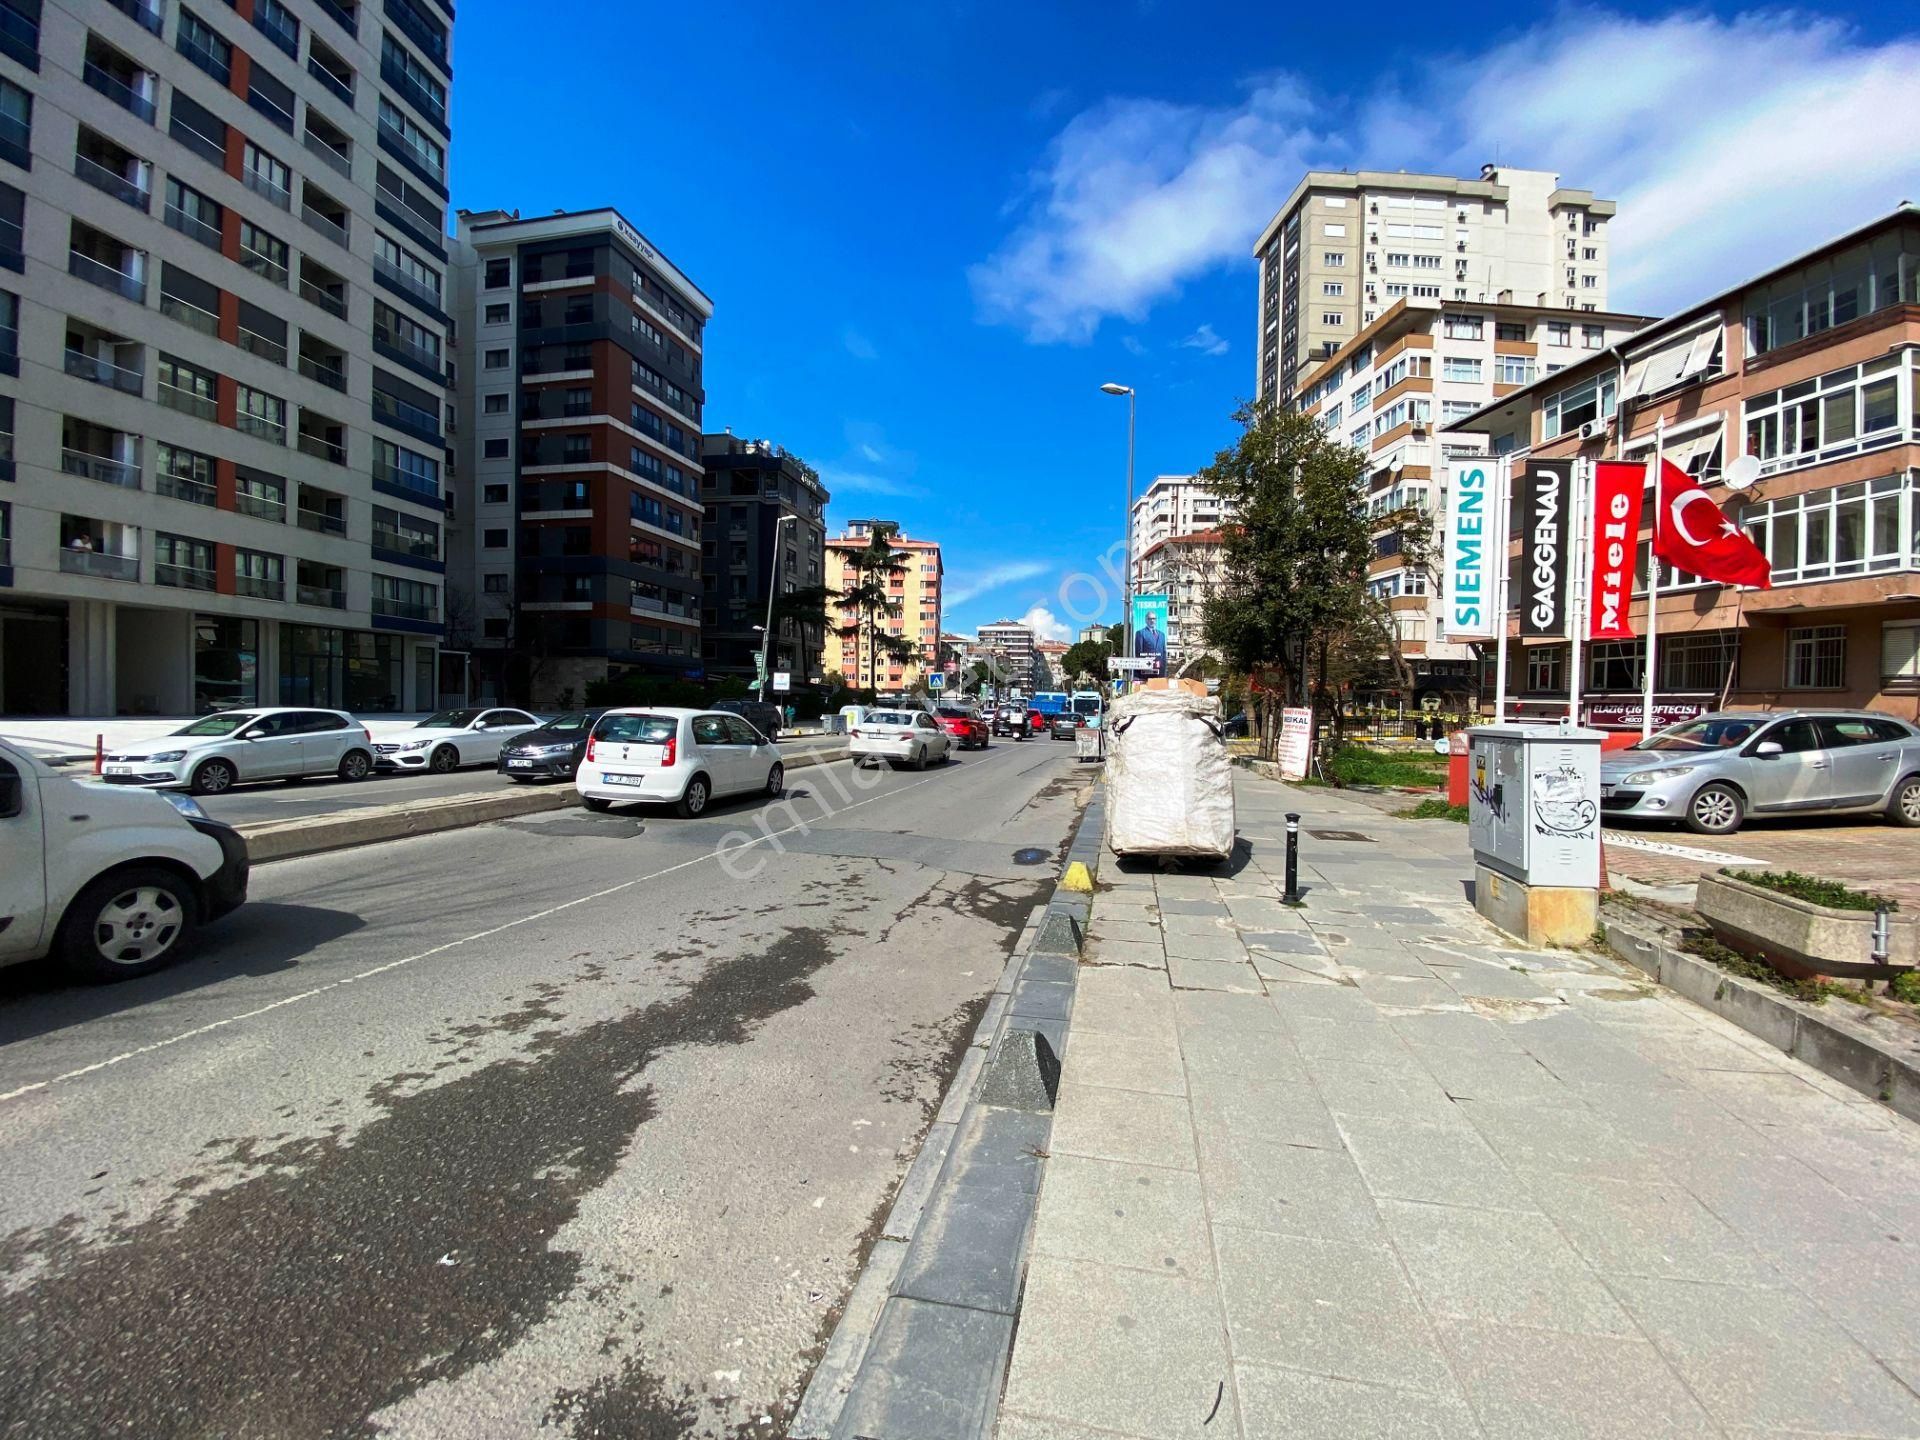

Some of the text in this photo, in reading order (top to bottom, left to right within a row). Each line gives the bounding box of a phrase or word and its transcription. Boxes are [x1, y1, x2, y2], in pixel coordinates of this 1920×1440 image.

[1455, 468, 1485, 626] SIEMENS
[1531, 469, 1560, 632] GAGGENAU
[1601, 493, 1630, 631] Miele
